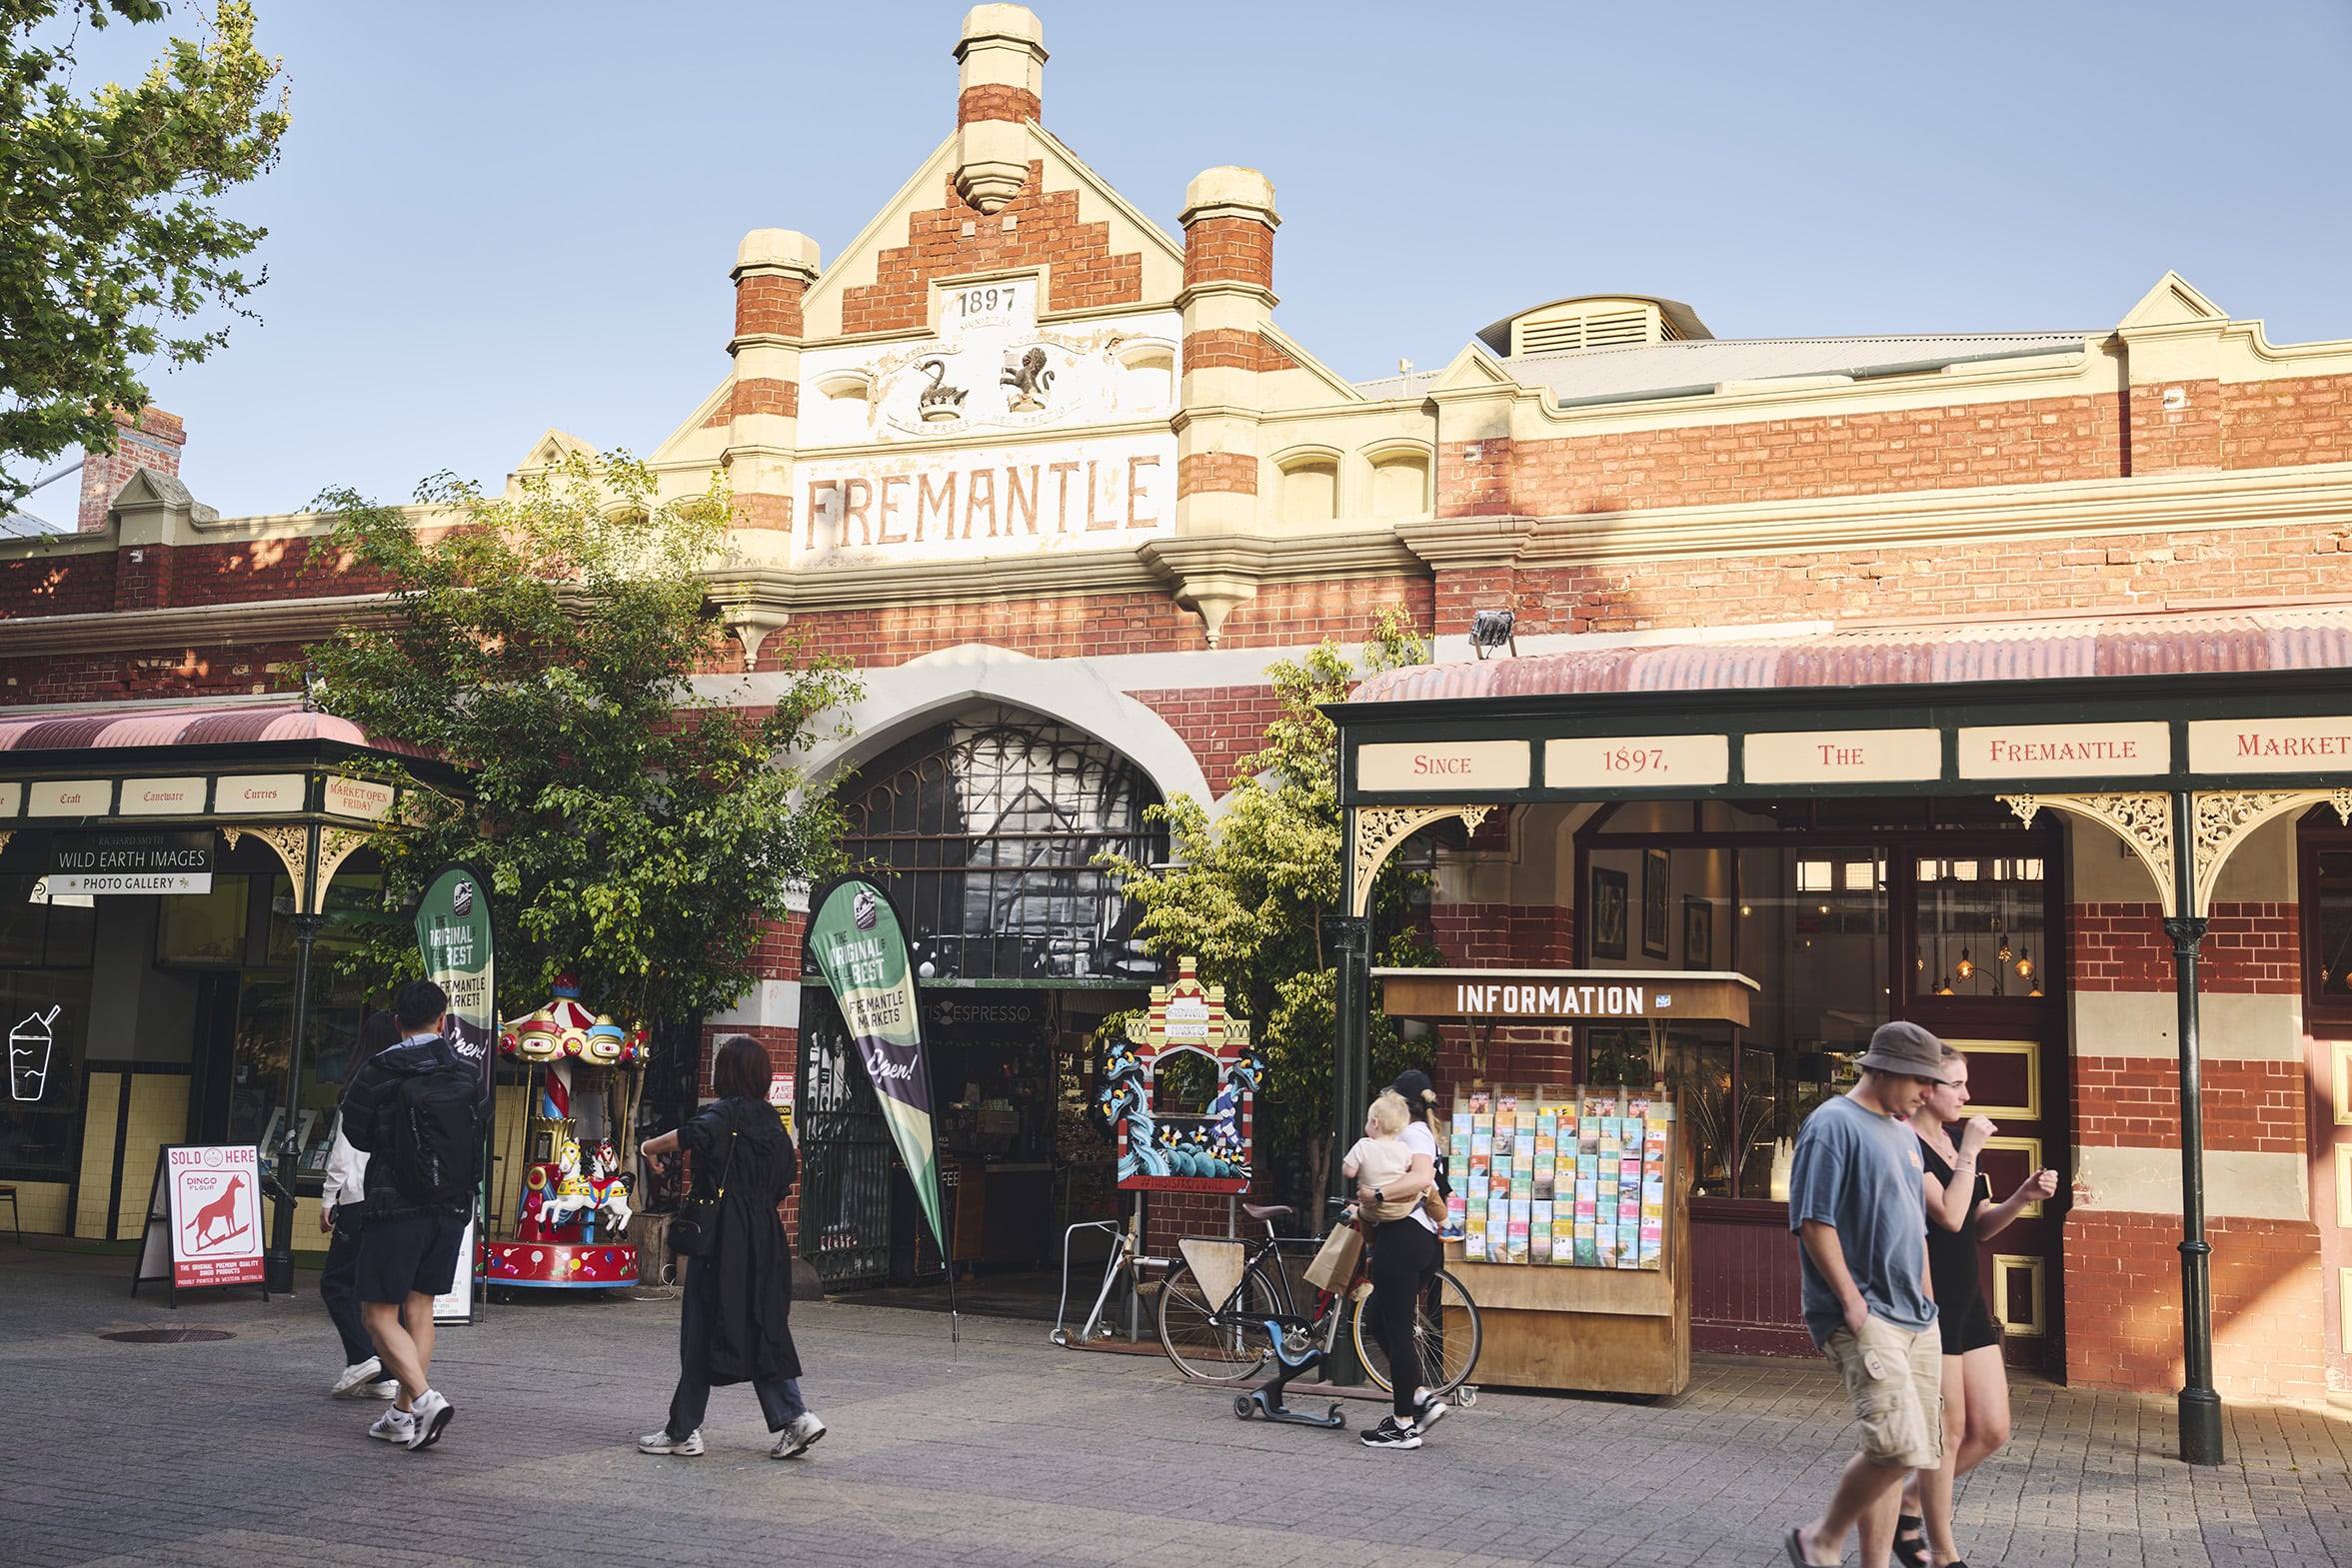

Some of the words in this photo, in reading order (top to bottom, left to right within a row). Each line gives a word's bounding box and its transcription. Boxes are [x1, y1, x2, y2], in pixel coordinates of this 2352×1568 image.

[959, 287, 1016, 317] 1897
[805, 455, 1161, 550] FREMANTLE
[1413, 755, 1471, 775] SINCE
[1817, 745, 1864, 766] THE
[1990, 740, 2137, 763] FREMANTLE
[2237, 734, 2351, 757] MARKET
[60, 792, 81, 803] Craft
[143, 790, 184, 802] Caneware
[243, 788, 278, 799] Curries
[329, 784, 366, 799] MARKET
[366, 790, 388, 802] OPEN
[343, 798, 373, 811] FRIDAY
[59, 851, 95, 868] WILD
[100, 850, 146, 867] EARTH
[150, 849, 206, 867] IMAGES
[83, 877, 122, 889] PHOTO
[125, 876, 175, 889] GALLERY
[834, 930, 848, 945] THE
[446, 944, 474, 966] BEST
[830, 937, 884, 967] ORIGINAL
[852, 958, 885, 984] BEST
[440, 976, 486, 992] FRMANTLE
[447, 992, 481, 1007] MRKETS
[1456, 984, 1644, 1015] INFORMATION
[858, 1007, 900, 1029] MARKETS
[953, 1005, 1031, 1021] ESPRESSO
[867, 1047, 919, 1084] Open!
[171, 1151, 201, 1165] SOLD
[225, 1149, 256, 1163] HERE
